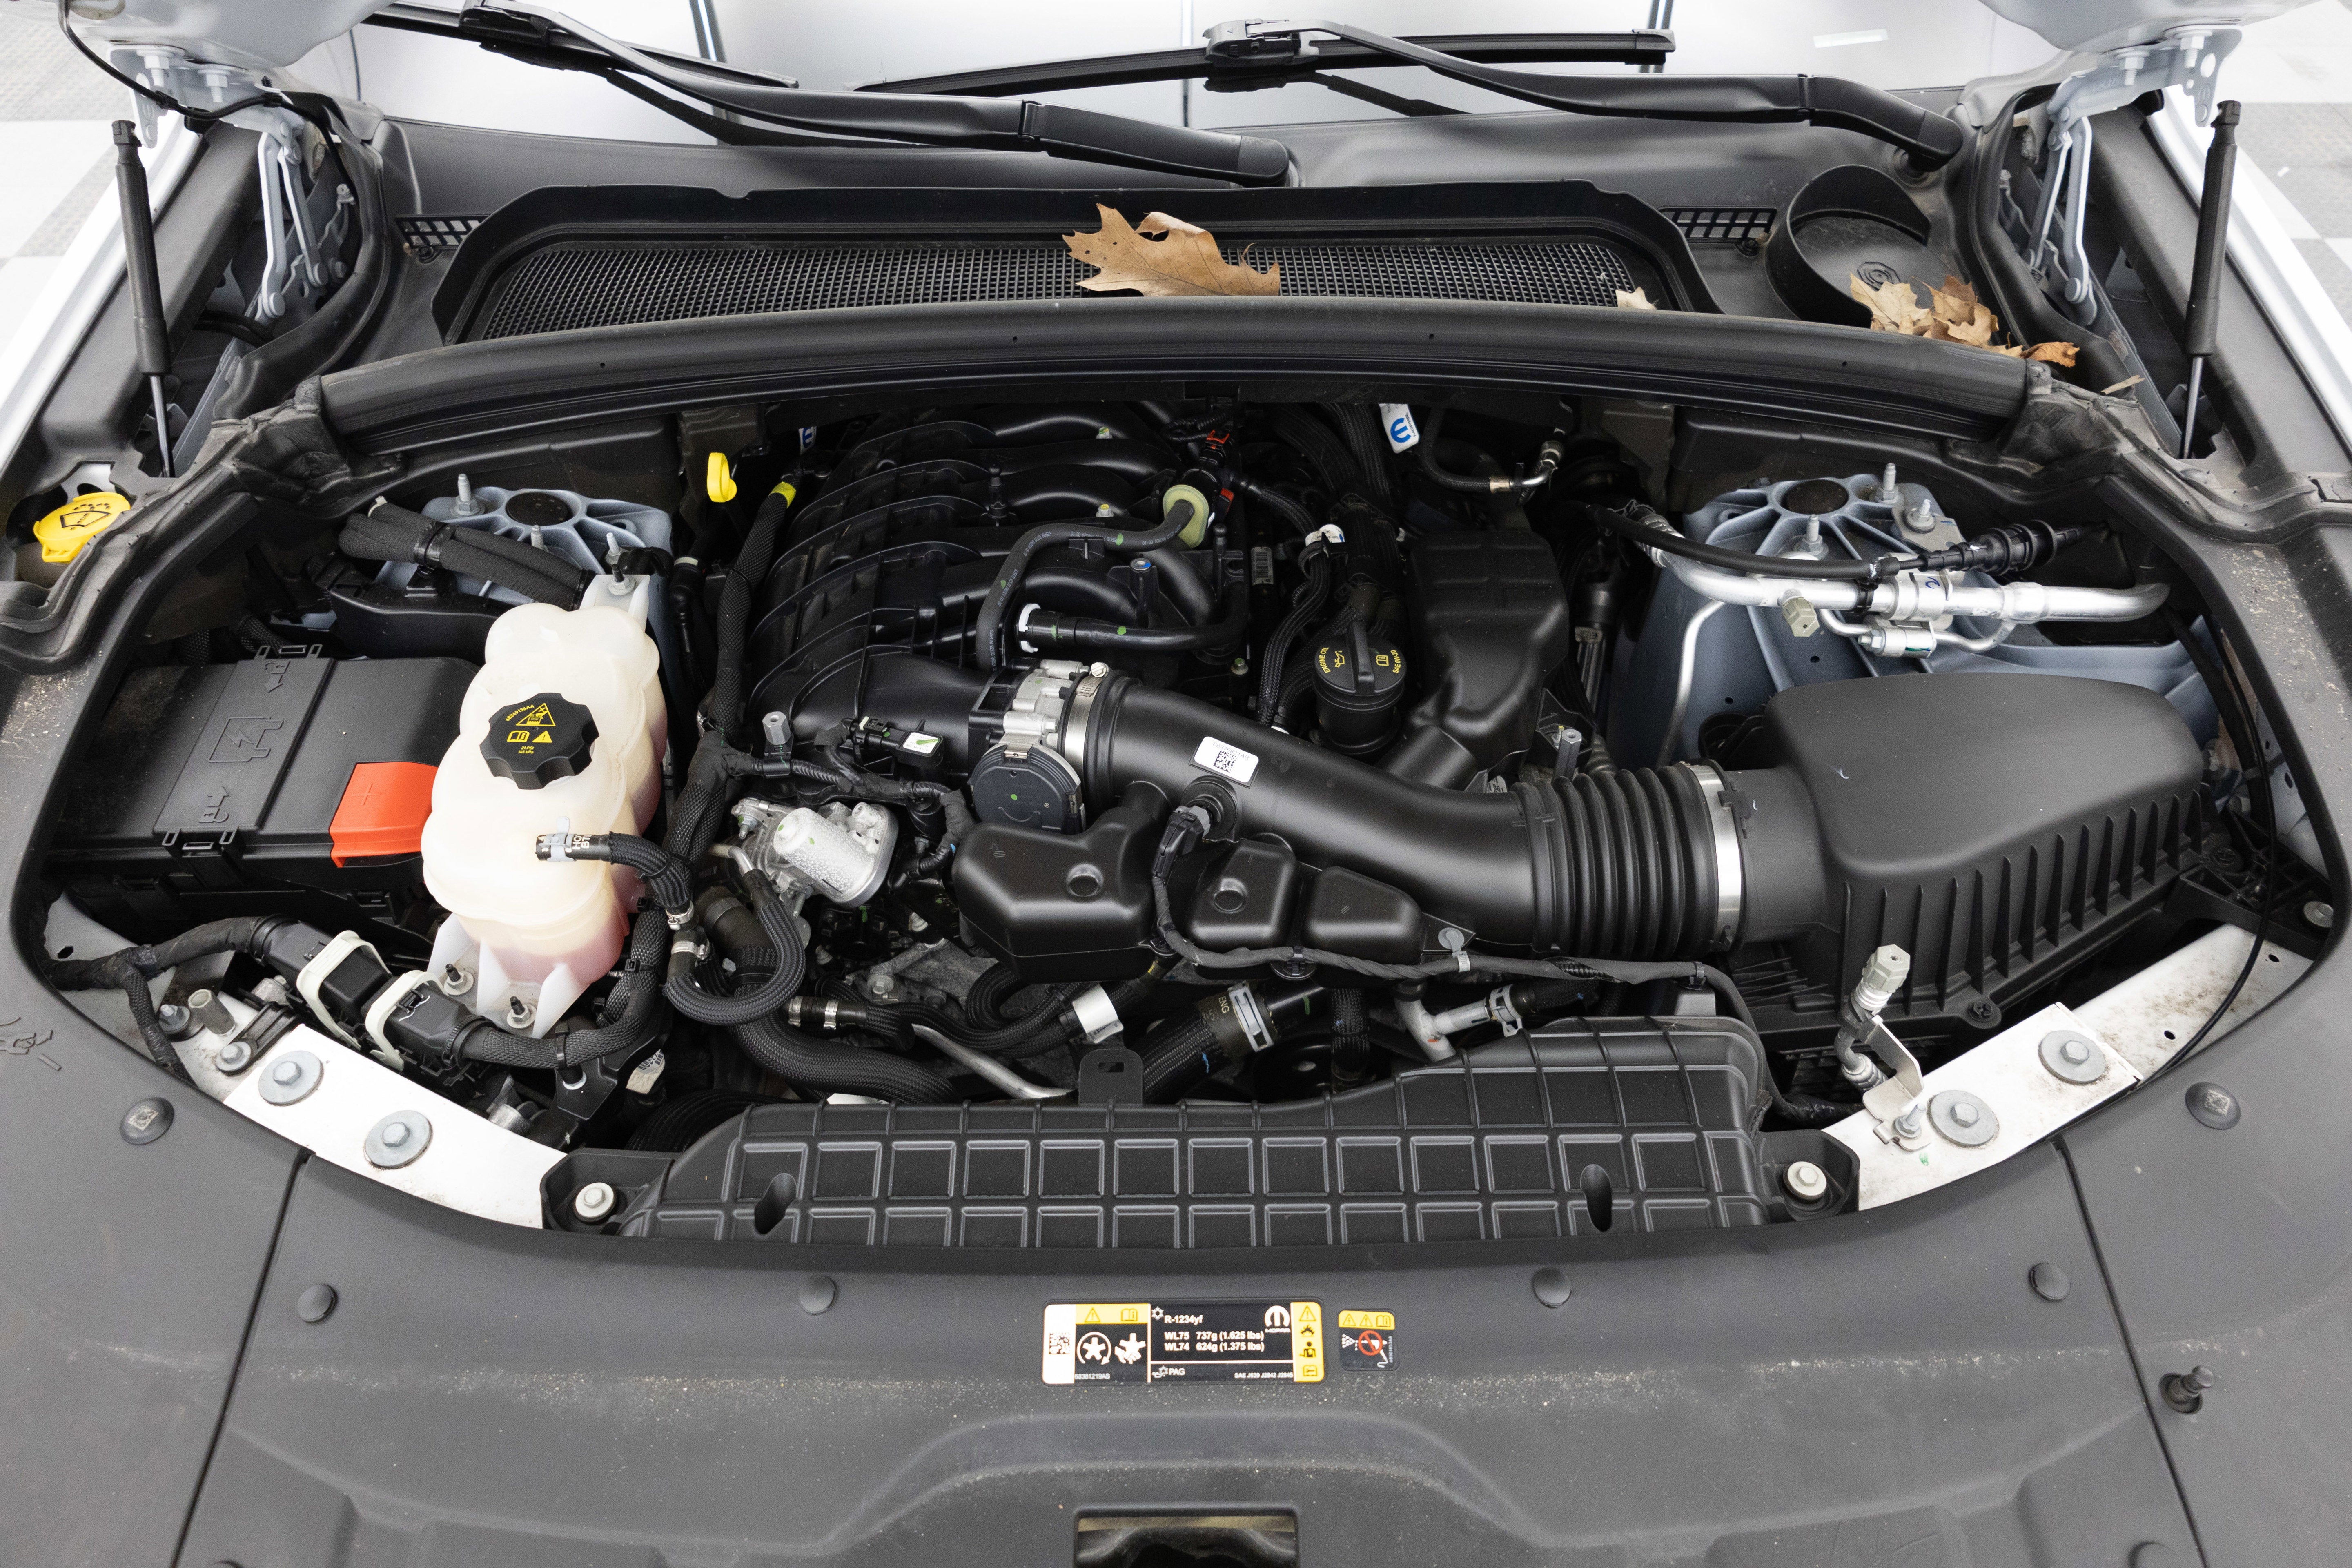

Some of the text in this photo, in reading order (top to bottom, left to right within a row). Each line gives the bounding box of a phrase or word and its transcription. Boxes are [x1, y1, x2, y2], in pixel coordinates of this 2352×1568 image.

[1319, 655, 1331, 673] ENGINE
[1390, 650, 1401, 673] SAE 0W-20
[1218, 996, 1229, 1013] ENG
[1164, 1315, 1203, 1325] R-1234yf
[1164, 1331, 1264, 1341] WL75 737g (1.625 lbs)
[1164, 1342, 1265, 1352] WL74 624g (1.375 lbs)
